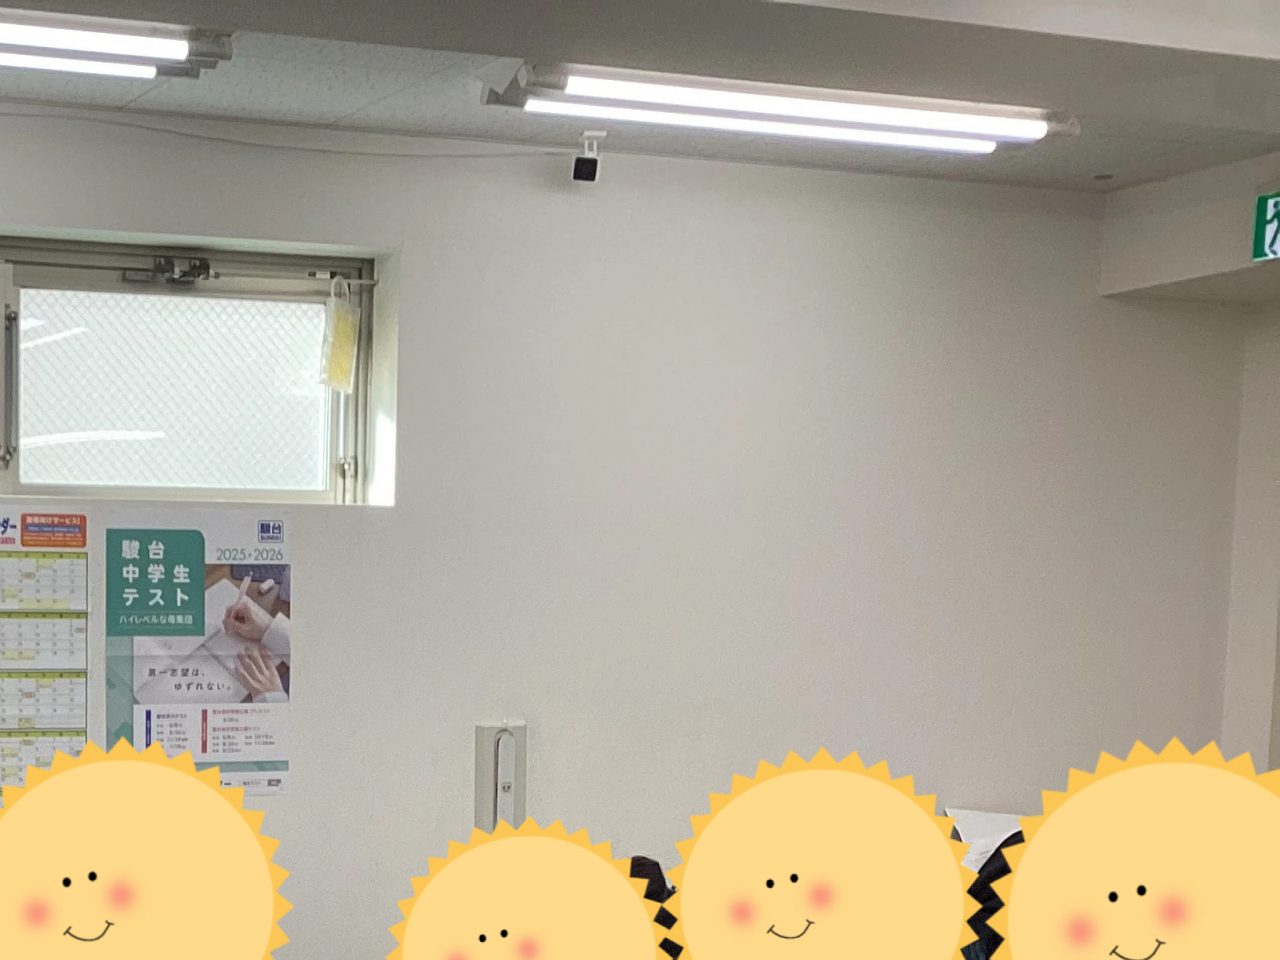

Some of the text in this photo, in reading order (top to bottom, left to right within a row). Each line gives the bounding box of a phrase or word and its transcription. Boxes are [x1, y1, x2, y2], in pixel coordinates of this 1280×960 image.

[122, 539, 165, 559] 駿台
[122, 563, 190, 583] 中学生
[122, 588, 189, 606] テスト
